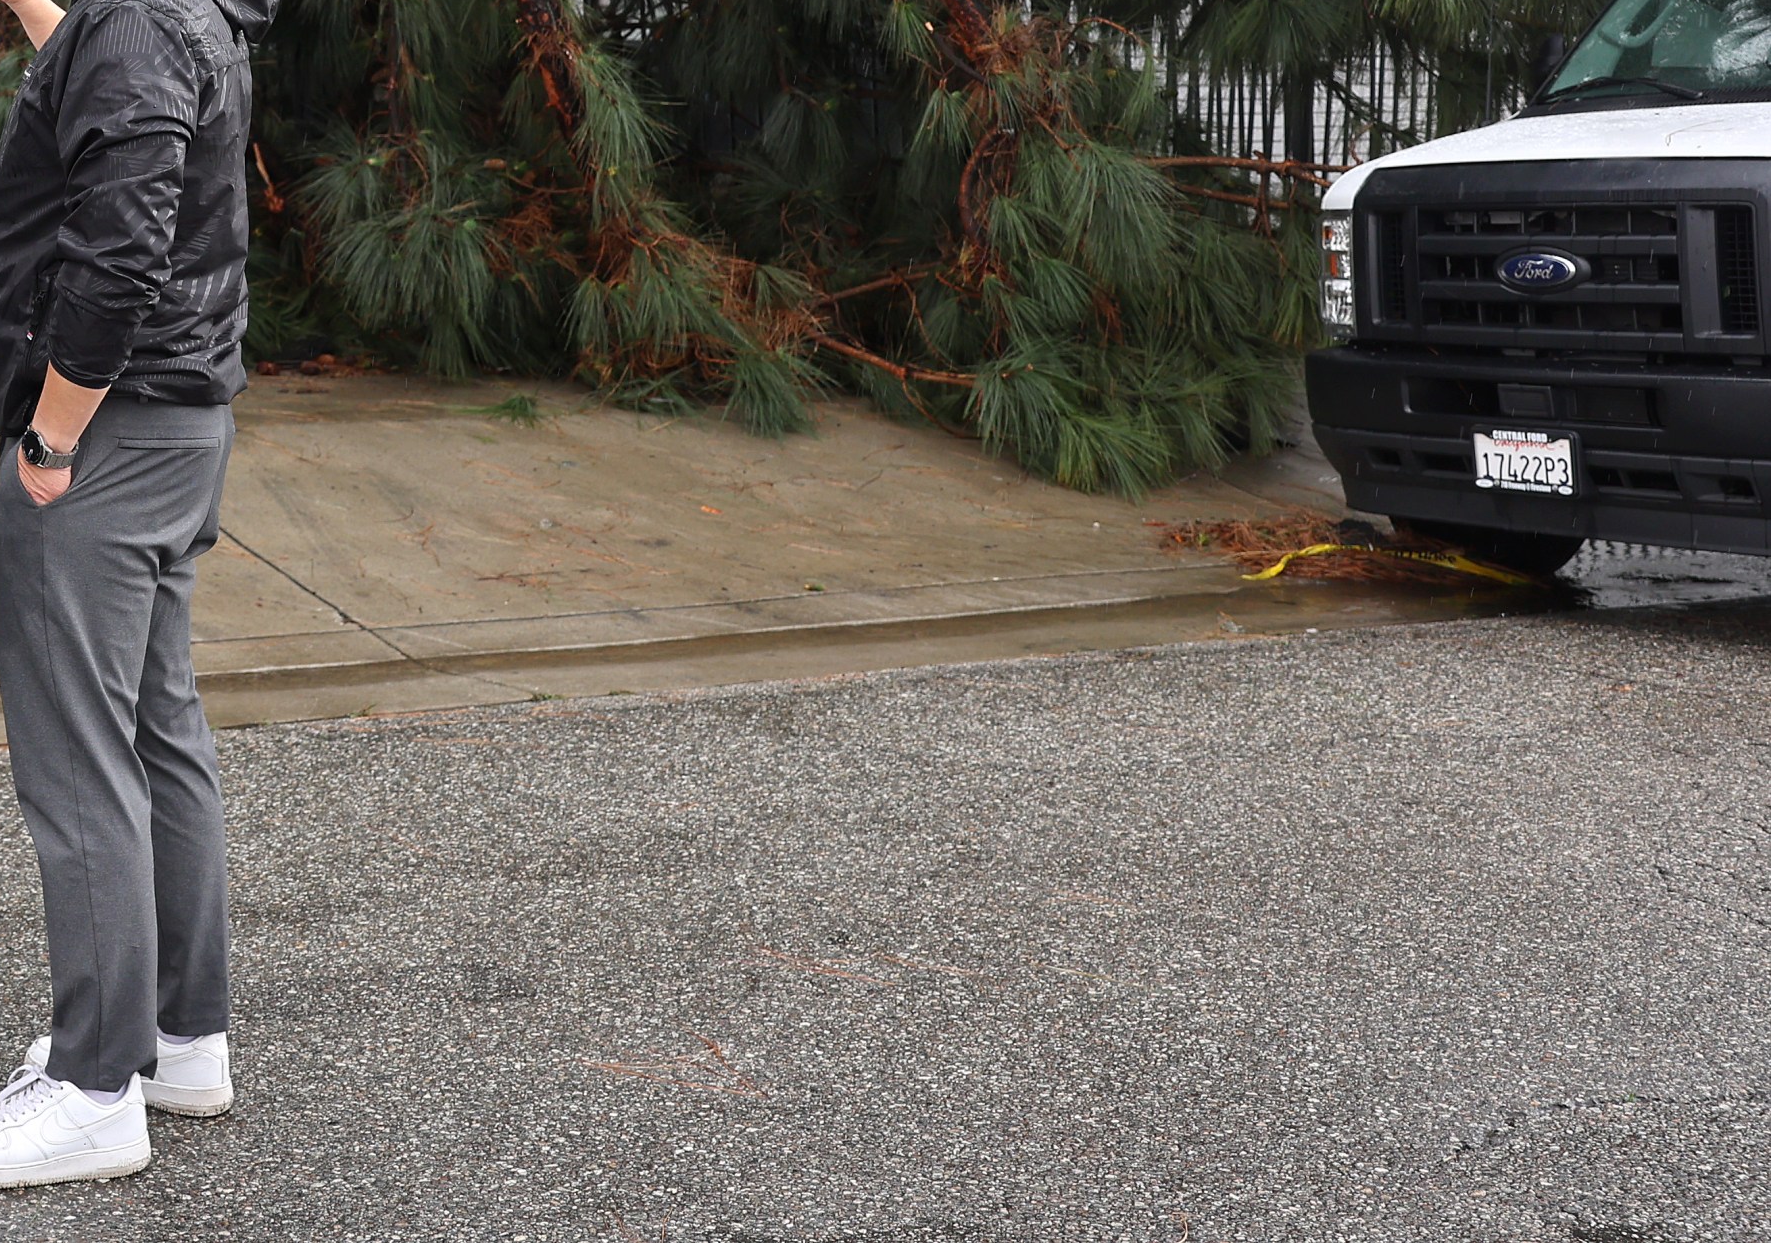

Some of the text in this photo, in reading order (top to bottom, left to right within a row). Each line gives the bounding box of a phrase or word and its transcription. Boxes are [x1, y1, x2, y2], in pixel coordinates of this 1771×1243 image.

[1514, 260, 1554, 279] Ford
[1492, 430, 1548, 443] CENTRAL FORD
[1482, 452, 1570, 486] 17422P3
